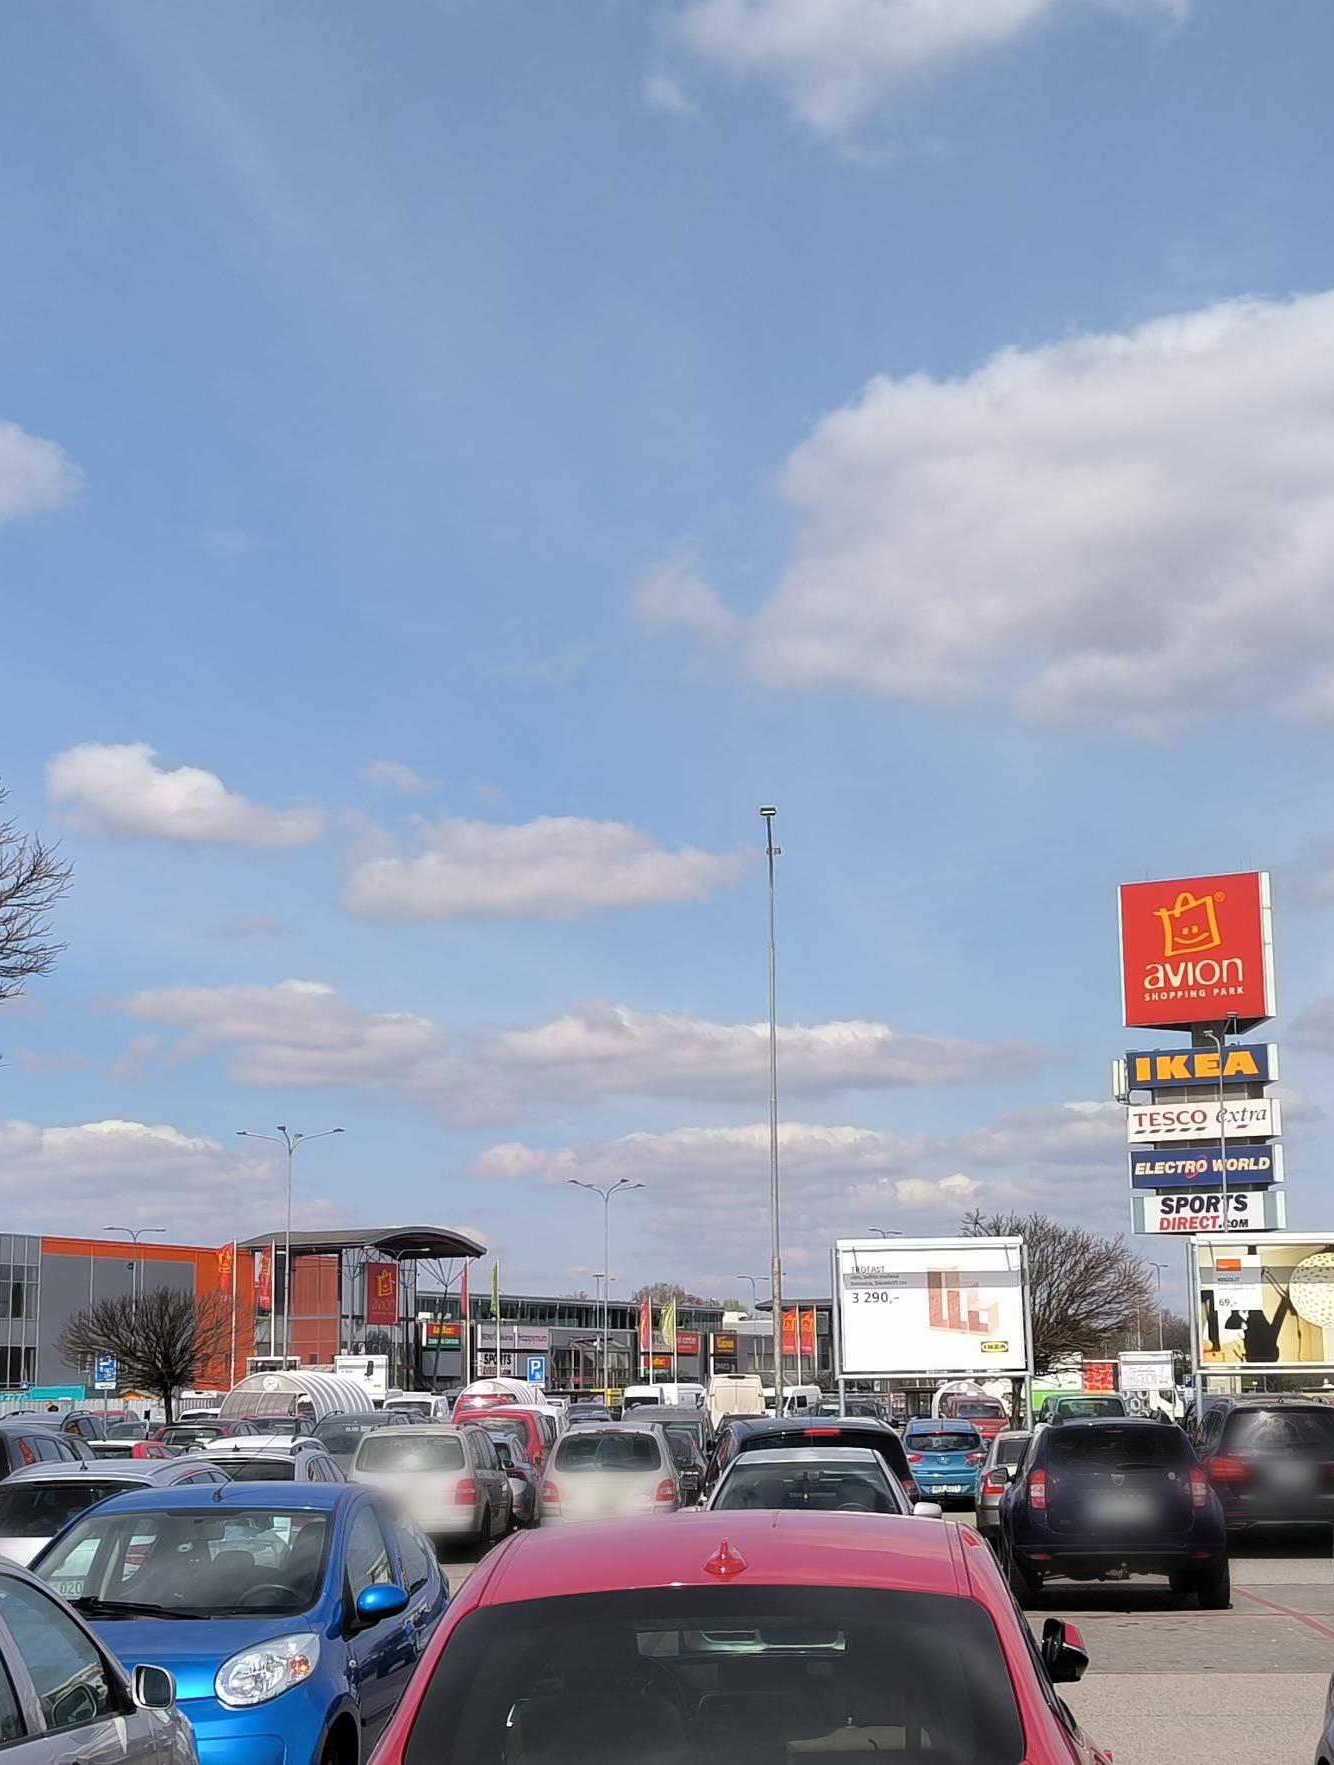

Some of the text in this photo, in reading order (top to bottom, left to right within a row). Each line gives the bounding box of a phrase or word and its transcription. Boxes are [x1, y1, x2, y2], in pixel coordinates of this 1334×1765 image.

[1143, 957, 1244, 989] avion
[1144, 986, 1244, 1001] SHOPPING PARK
[1136, 1051, 1259, 1081] IKEA
[1133, 1107, 1267, 1127] TESCO extra
[1135, 1157, 1271, 1176] ELECTRO WORLD
[1160, 1194, 1249, 1214] SPORTS
[531, 1360, 541, 1375] P
[1185, 1376, 1191, 1385] P
